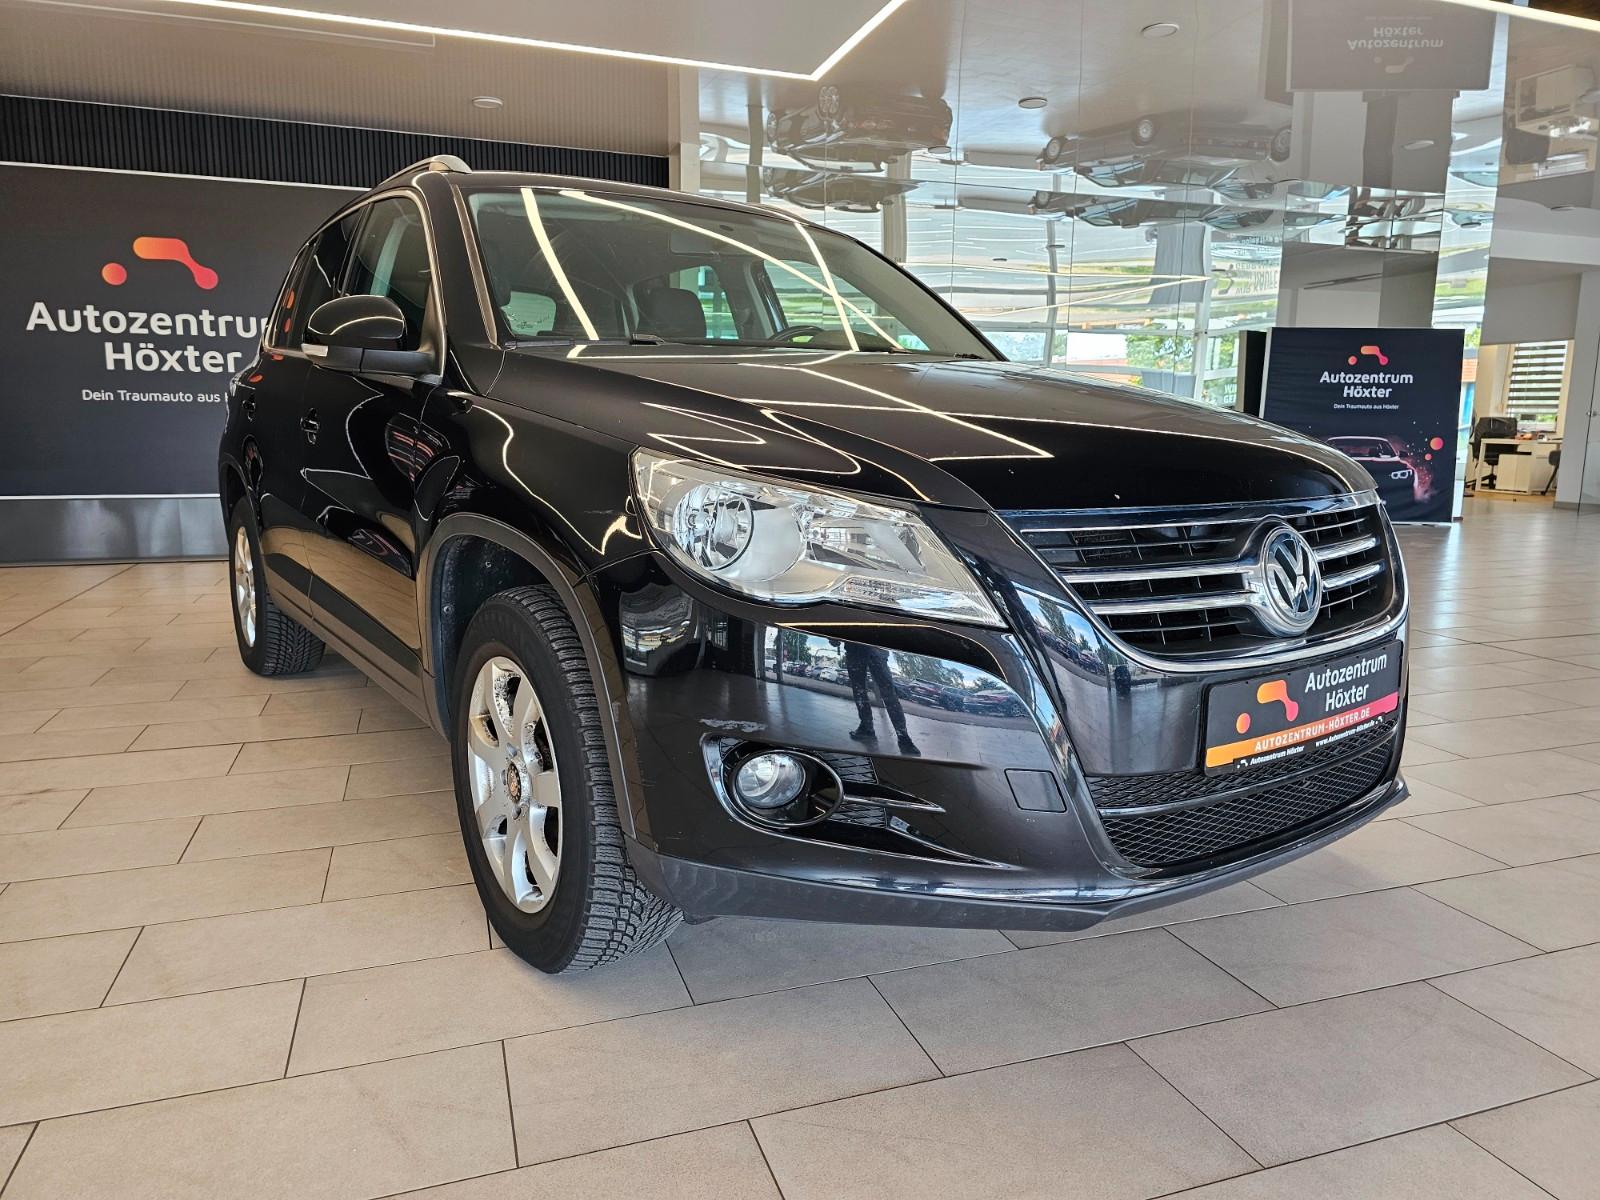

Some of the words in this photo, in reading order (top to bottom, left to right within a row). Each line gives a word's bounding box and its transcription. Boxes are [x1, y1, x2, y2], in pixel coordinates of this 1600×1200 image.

[26, 301, 269, 338] Autozentru
[104, 341, 242, 373] Höxter
[1319, 371, 1414, 384] Autozentrum
[1343, 385, 1393, 398] Höxter
[81, 389, 114, 401] Dein
[117, 390, 194, 402] Traumauto
[197, 393, 221, 403] aus
[1304, 654, 1388, 693] Autozentrum
[1325, 682, 1370, 712] Höxter
[1254, 706, 1371, 753] AUTOZENTRUM-HÖXTER.DE
